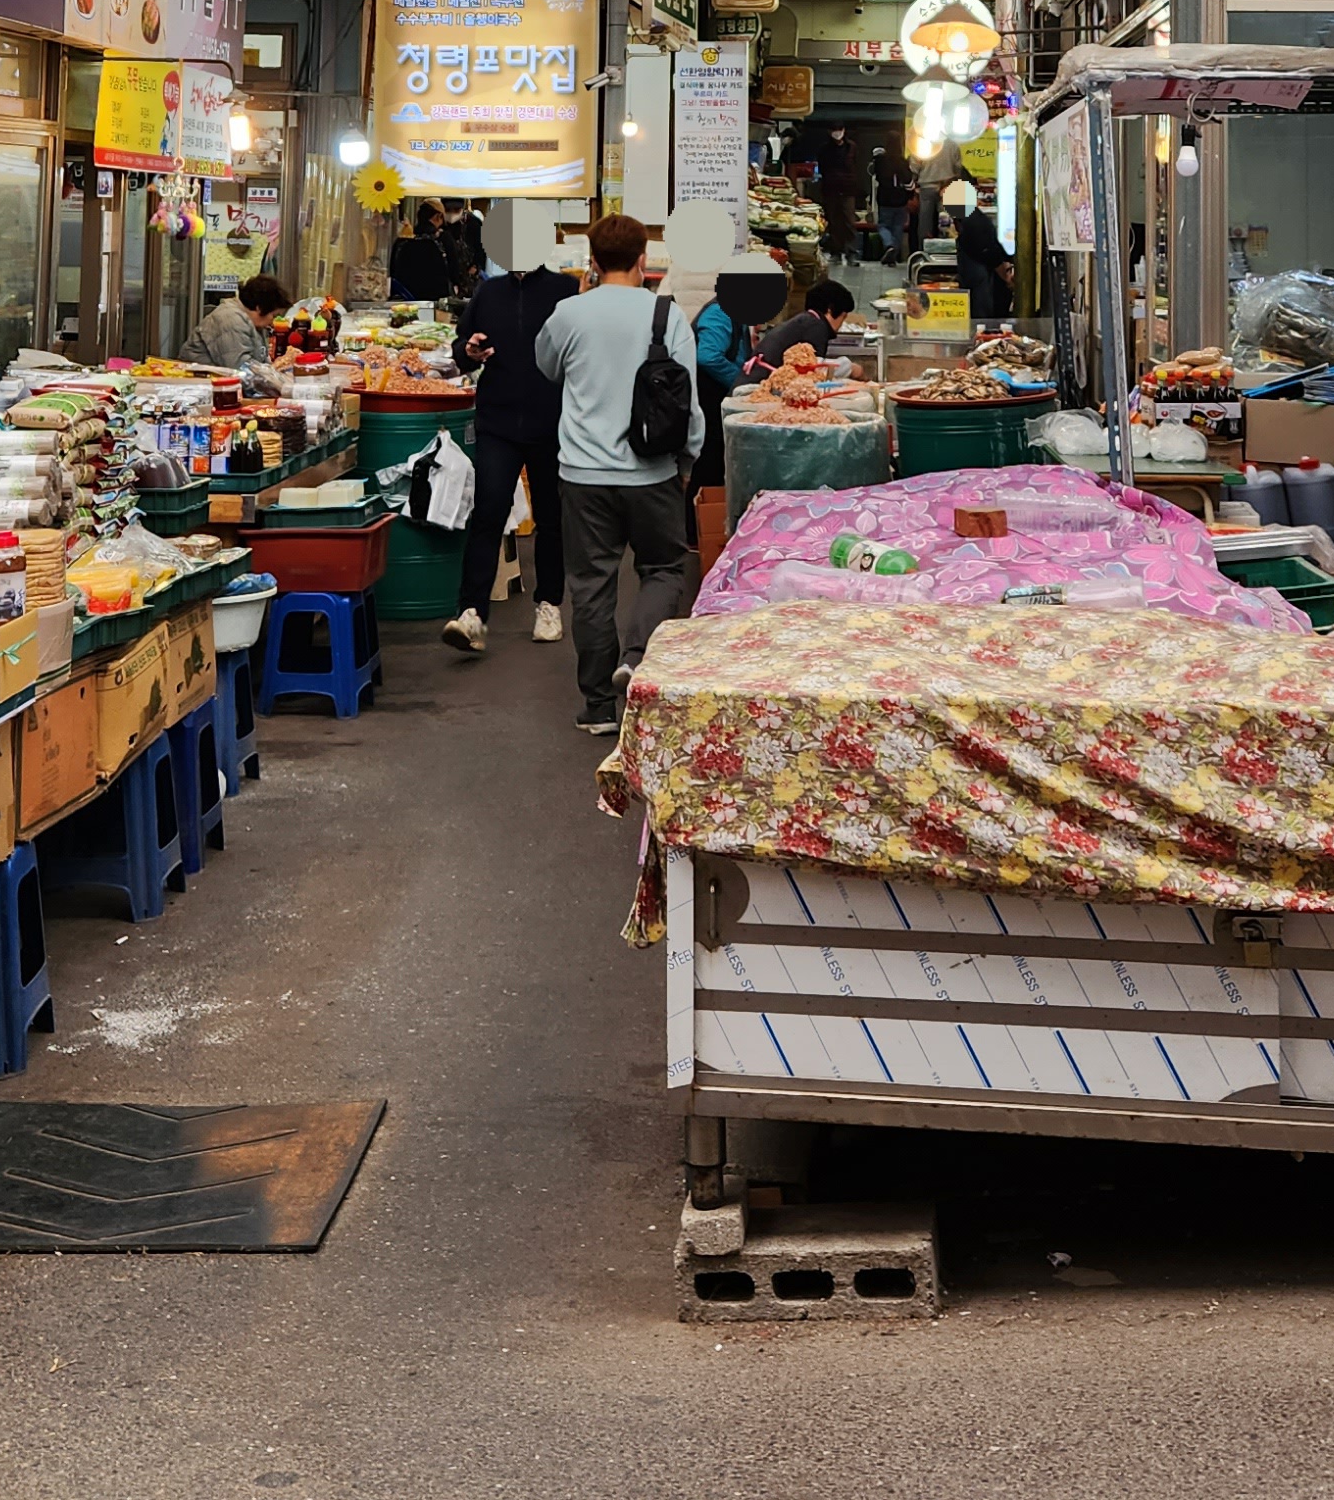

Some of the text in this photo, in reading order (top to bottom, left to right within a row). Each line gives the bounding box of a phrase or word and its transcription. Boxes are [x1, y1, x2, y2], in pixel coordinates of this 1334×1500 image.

[396, 42, 578, 96] 청령포맛집
[408, 139, 474, 151] TEL 375 7557
